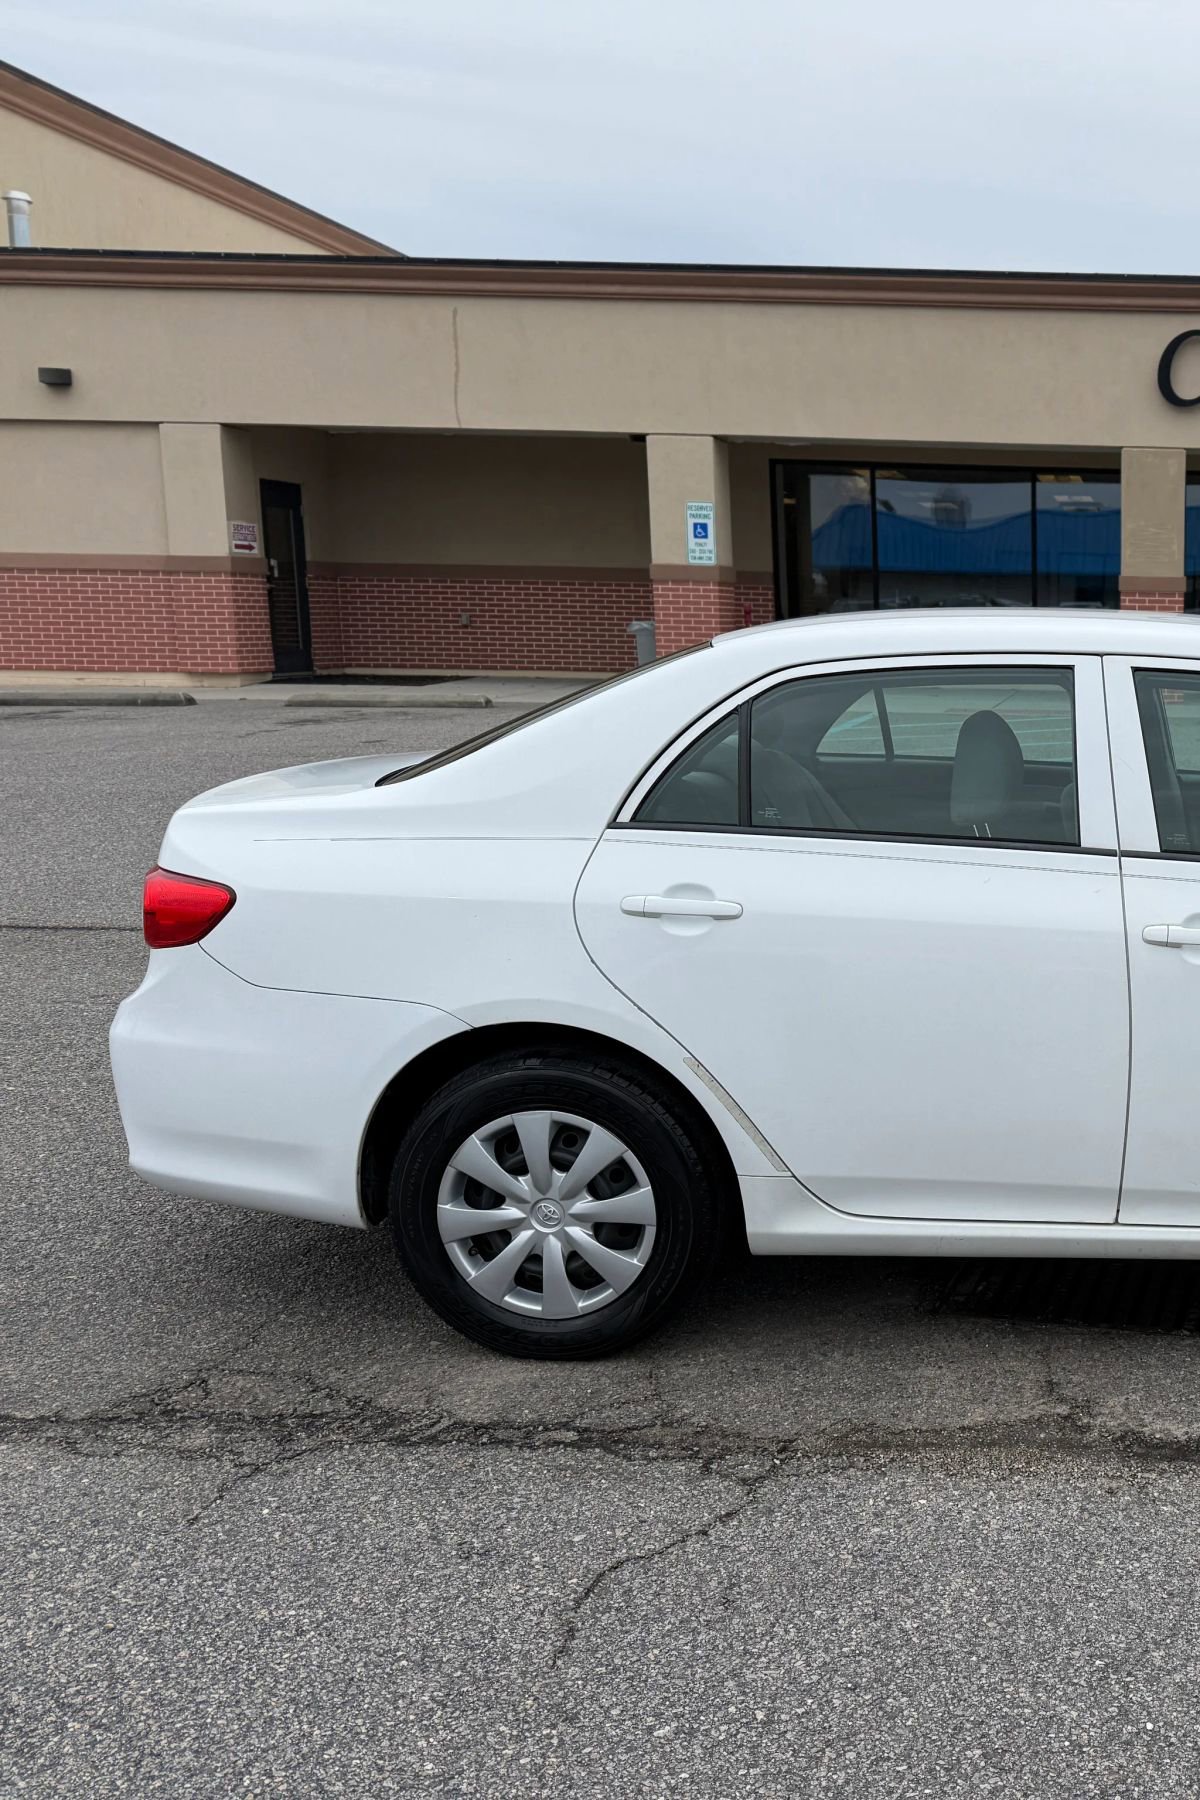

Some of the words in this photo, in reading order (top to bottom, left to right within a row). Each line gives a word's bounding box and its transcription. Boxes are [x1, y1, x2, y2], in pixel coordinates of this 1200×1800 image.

[687, 504, 713, 512] RESERVED
[688, 512, 712, 520] PARKING
[232, 523, 256, 533] SERVICE
